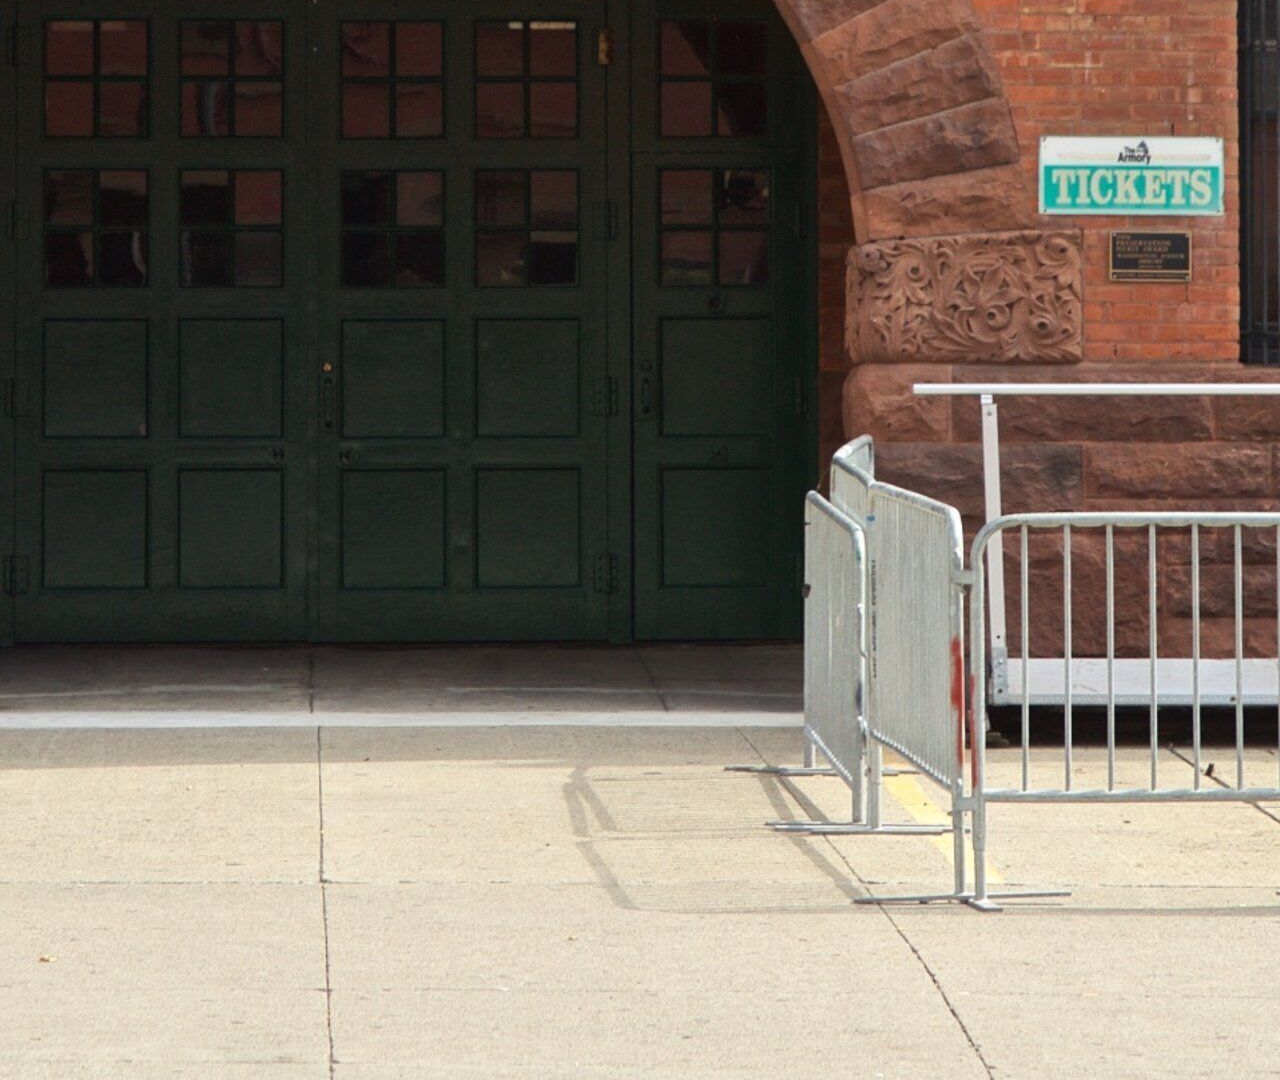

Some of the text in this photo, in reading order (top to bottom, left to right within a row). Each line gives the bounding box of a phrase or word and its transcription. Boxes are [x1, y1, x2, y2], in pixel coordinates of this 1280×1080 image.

[1124, 146, 1136, 154] The
[1117, 152, 1152, 165] Armory
[1051, 168, 1213, 206] TICKETS
